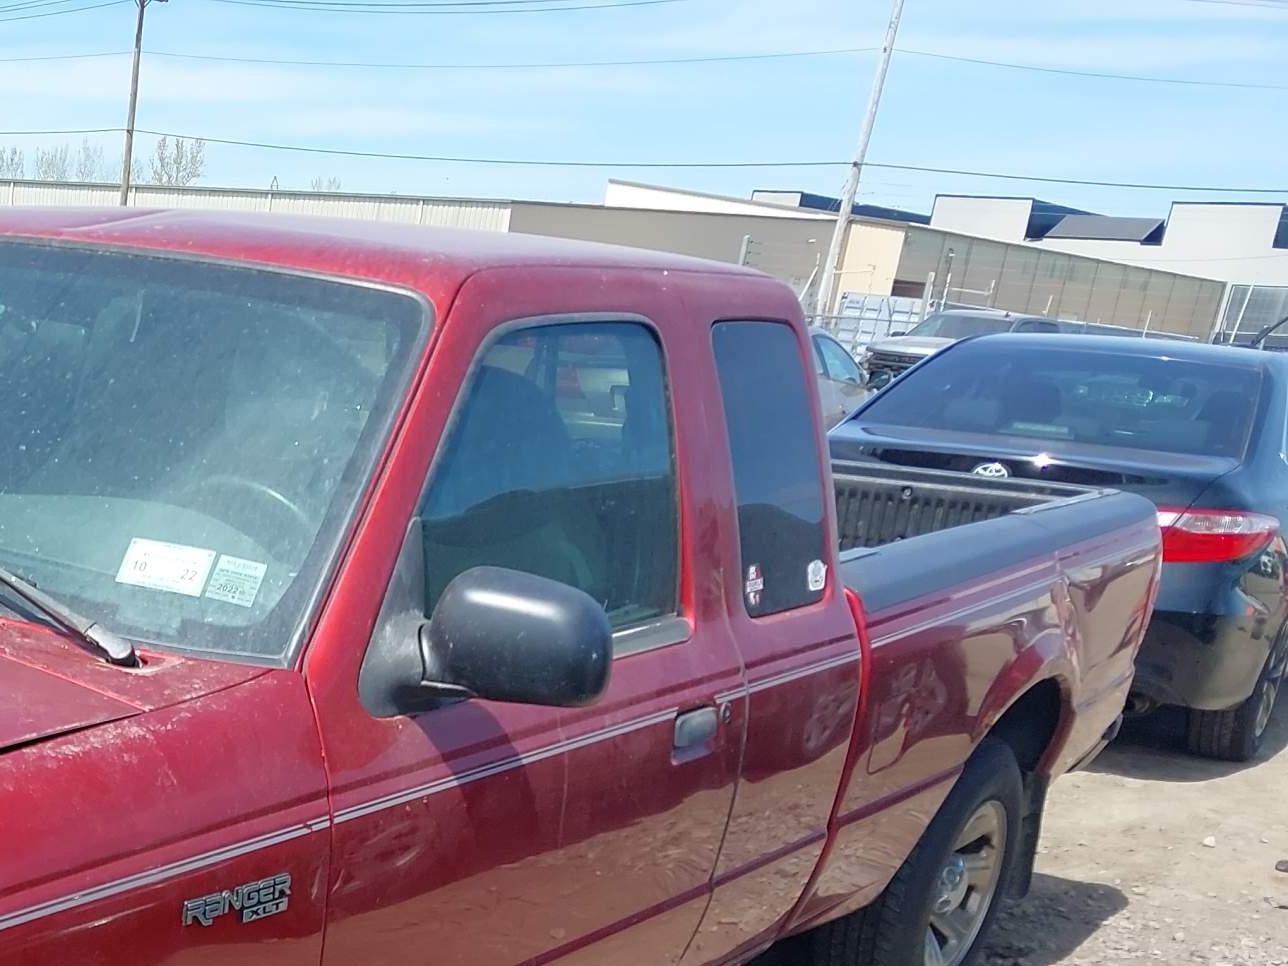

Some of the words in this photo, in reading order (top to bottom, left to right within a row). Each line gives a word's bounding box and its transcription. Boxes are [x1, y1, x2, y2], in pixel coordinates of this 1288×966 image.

[180, 568, 198, 582] 22
[216, 582, 240, 596] 2022
[182, 872, 292, 927] RANGER
[249, 900, 285, 918] XLT
